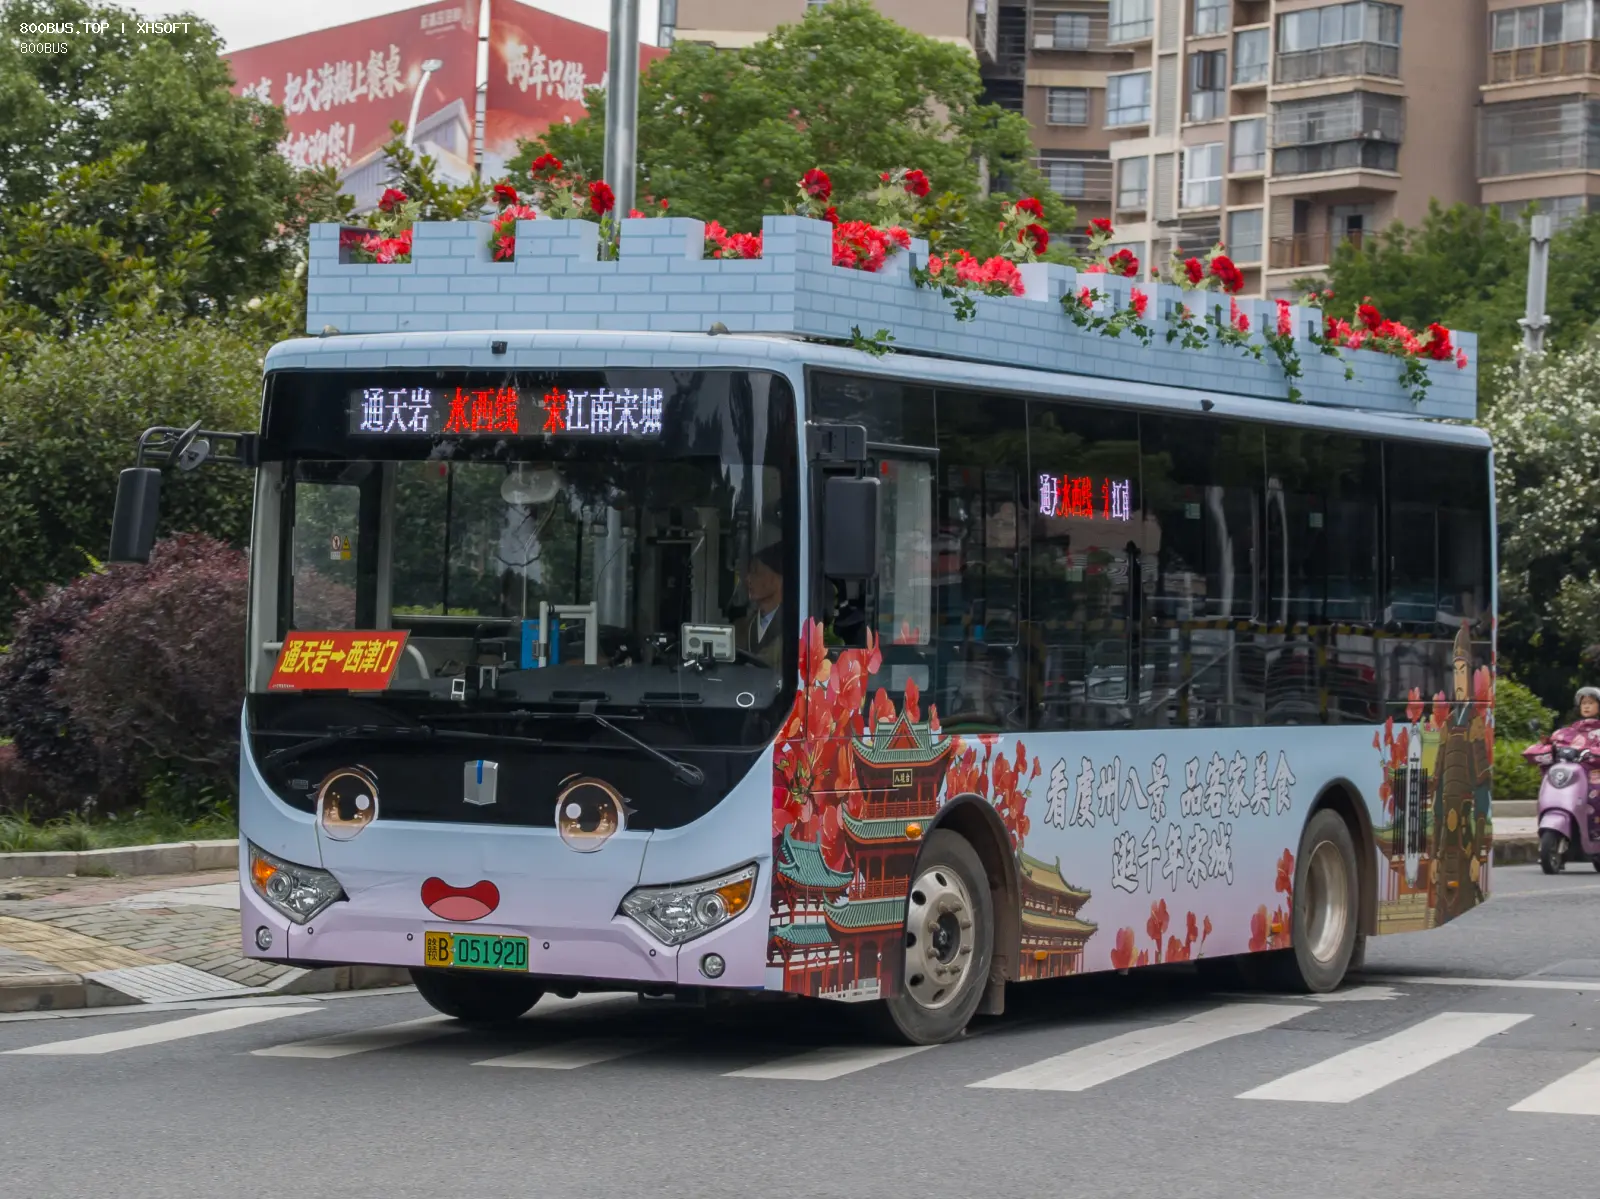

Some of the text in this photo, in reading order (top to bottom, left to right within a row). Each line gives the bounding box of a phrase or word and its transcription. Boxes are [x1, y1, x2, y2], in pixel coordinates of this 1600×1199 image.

[360, 387, 432, 434] 通天岩
[1180, 749, 1297, 819] 品客家美食
